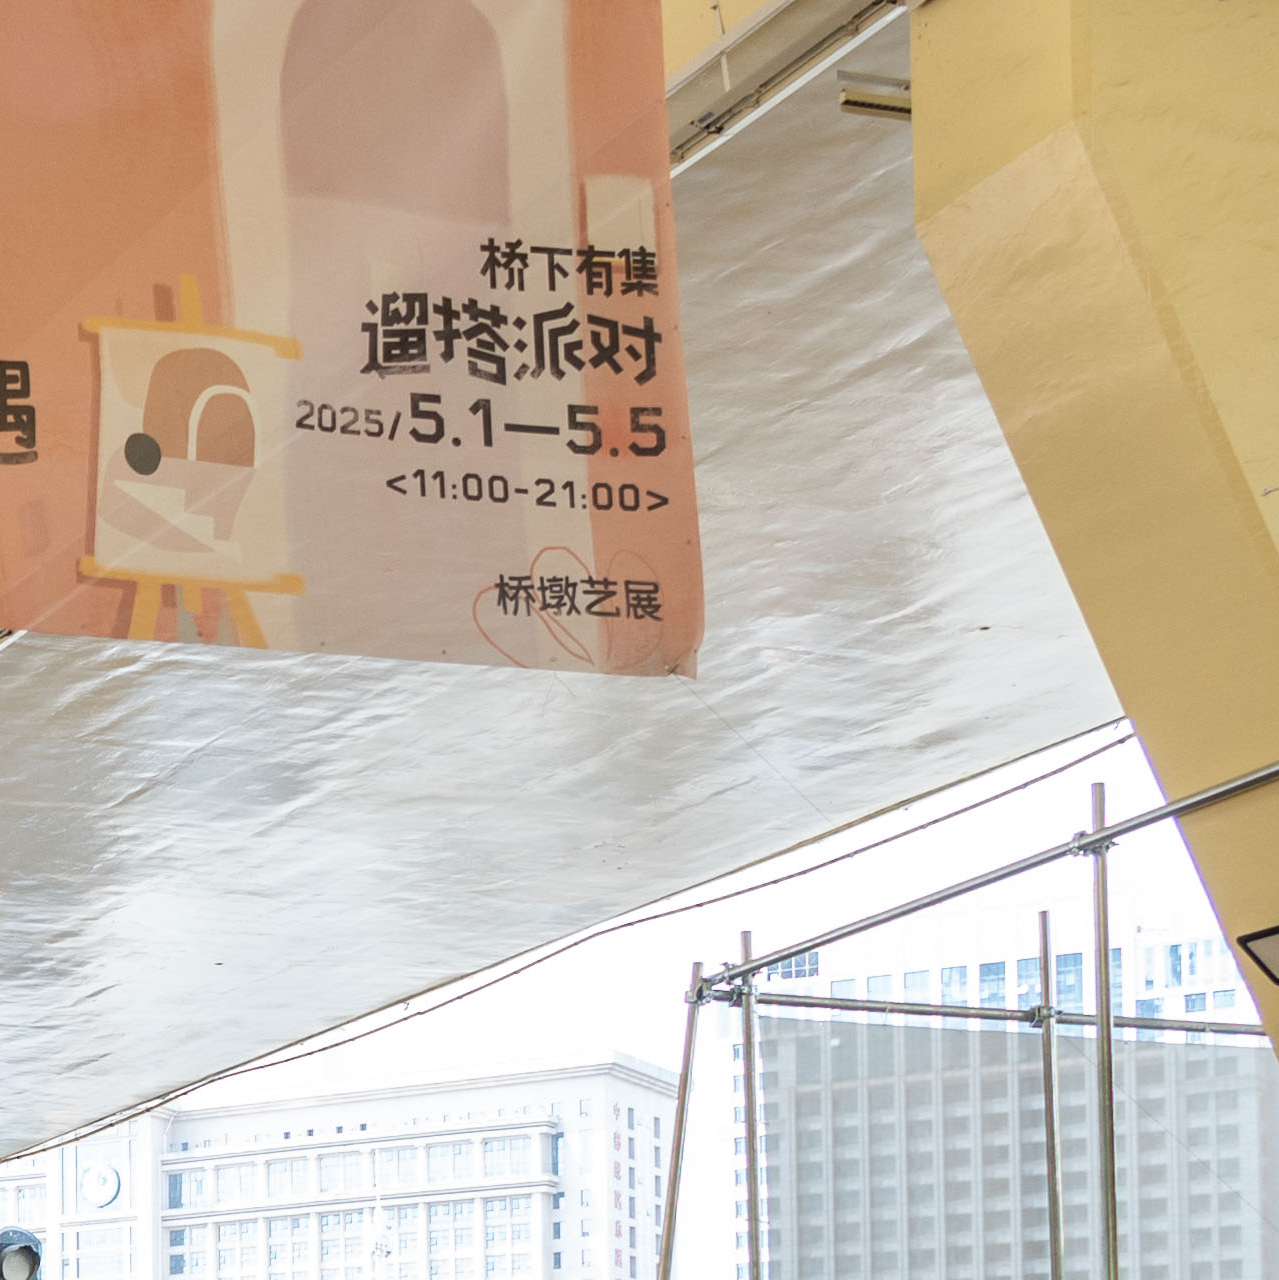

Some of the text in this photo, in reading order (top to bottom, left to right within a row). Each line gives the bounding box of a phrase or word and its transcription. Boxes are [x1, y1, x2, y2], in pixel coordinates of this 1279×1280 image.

[480, 238, 659, 297] 桥下有集
[359, 291, 663, 385] 遛搭派对
[384, 468, 670, 513] <11:00-21:00>
[495, 573, 664, 622] 桥墩艺展
